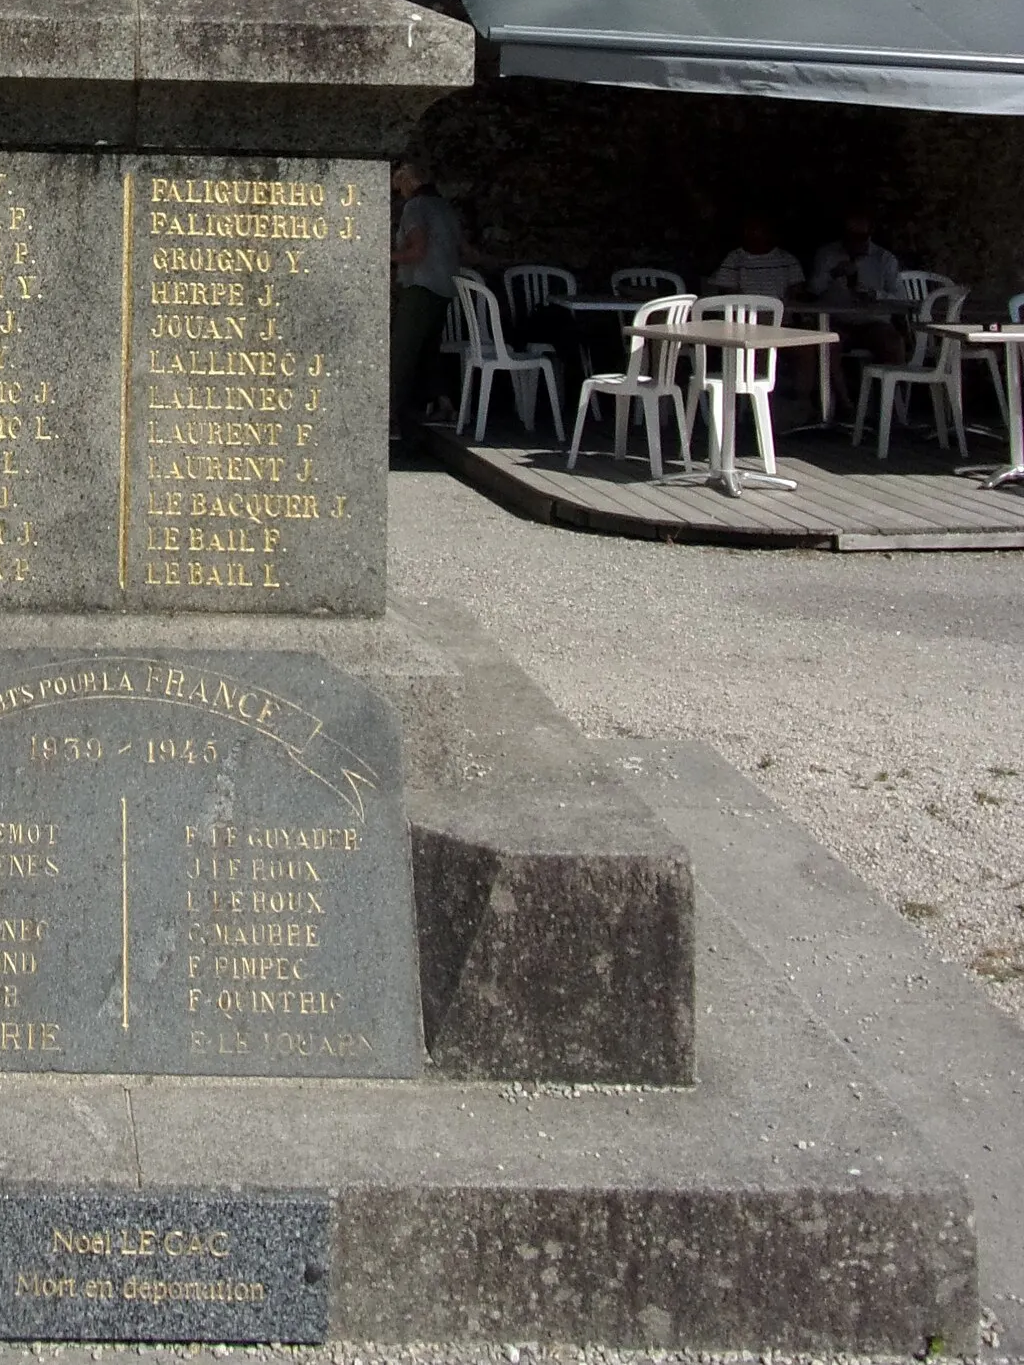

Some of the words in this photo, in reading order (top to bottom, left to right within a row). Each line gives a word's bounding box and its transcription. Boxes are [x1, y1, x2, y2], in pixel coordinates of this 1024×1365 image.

[151, 179, 324, 206] FALIGUERHO
[151, 212, 328, 239] FALIGUERHO
[151, 282, 244, 306] HERPE
[151, 315, 246, 339] JOUAN
[149, 351, 296, 376] LALLINEC
[149, 386, 293, 411] LALLINEC
[148, 421, 283, 446] LAURENT
[148, 456, 285, 481] LAURENT
[190, 493, 320, 524] BACQUER
[188, 528, 255, 552] BAIL
[188, 563, 253, 586] BAIL
[40, 671, 96, 699] POUR
[102, 670, 134, 692] LA
[146, 666, 281, 724] FRANCE
[30, 735, 102, 762] 1939
[146, 737, 217, 765] 1945
[252, 859, 322, 882] ROUX
[213, 891, 244, 912] LE
[252, 891, 326, 914] ROUX
[188, 955, 201, 979] F
[188, 989, 202, 1012] F
[121, 1230, 156, 1256] LE
[164, 1231, 230, 1258] GAC
[15, 1272, 76, 1298] Mort
[85, 1280, 113, 1299] en
